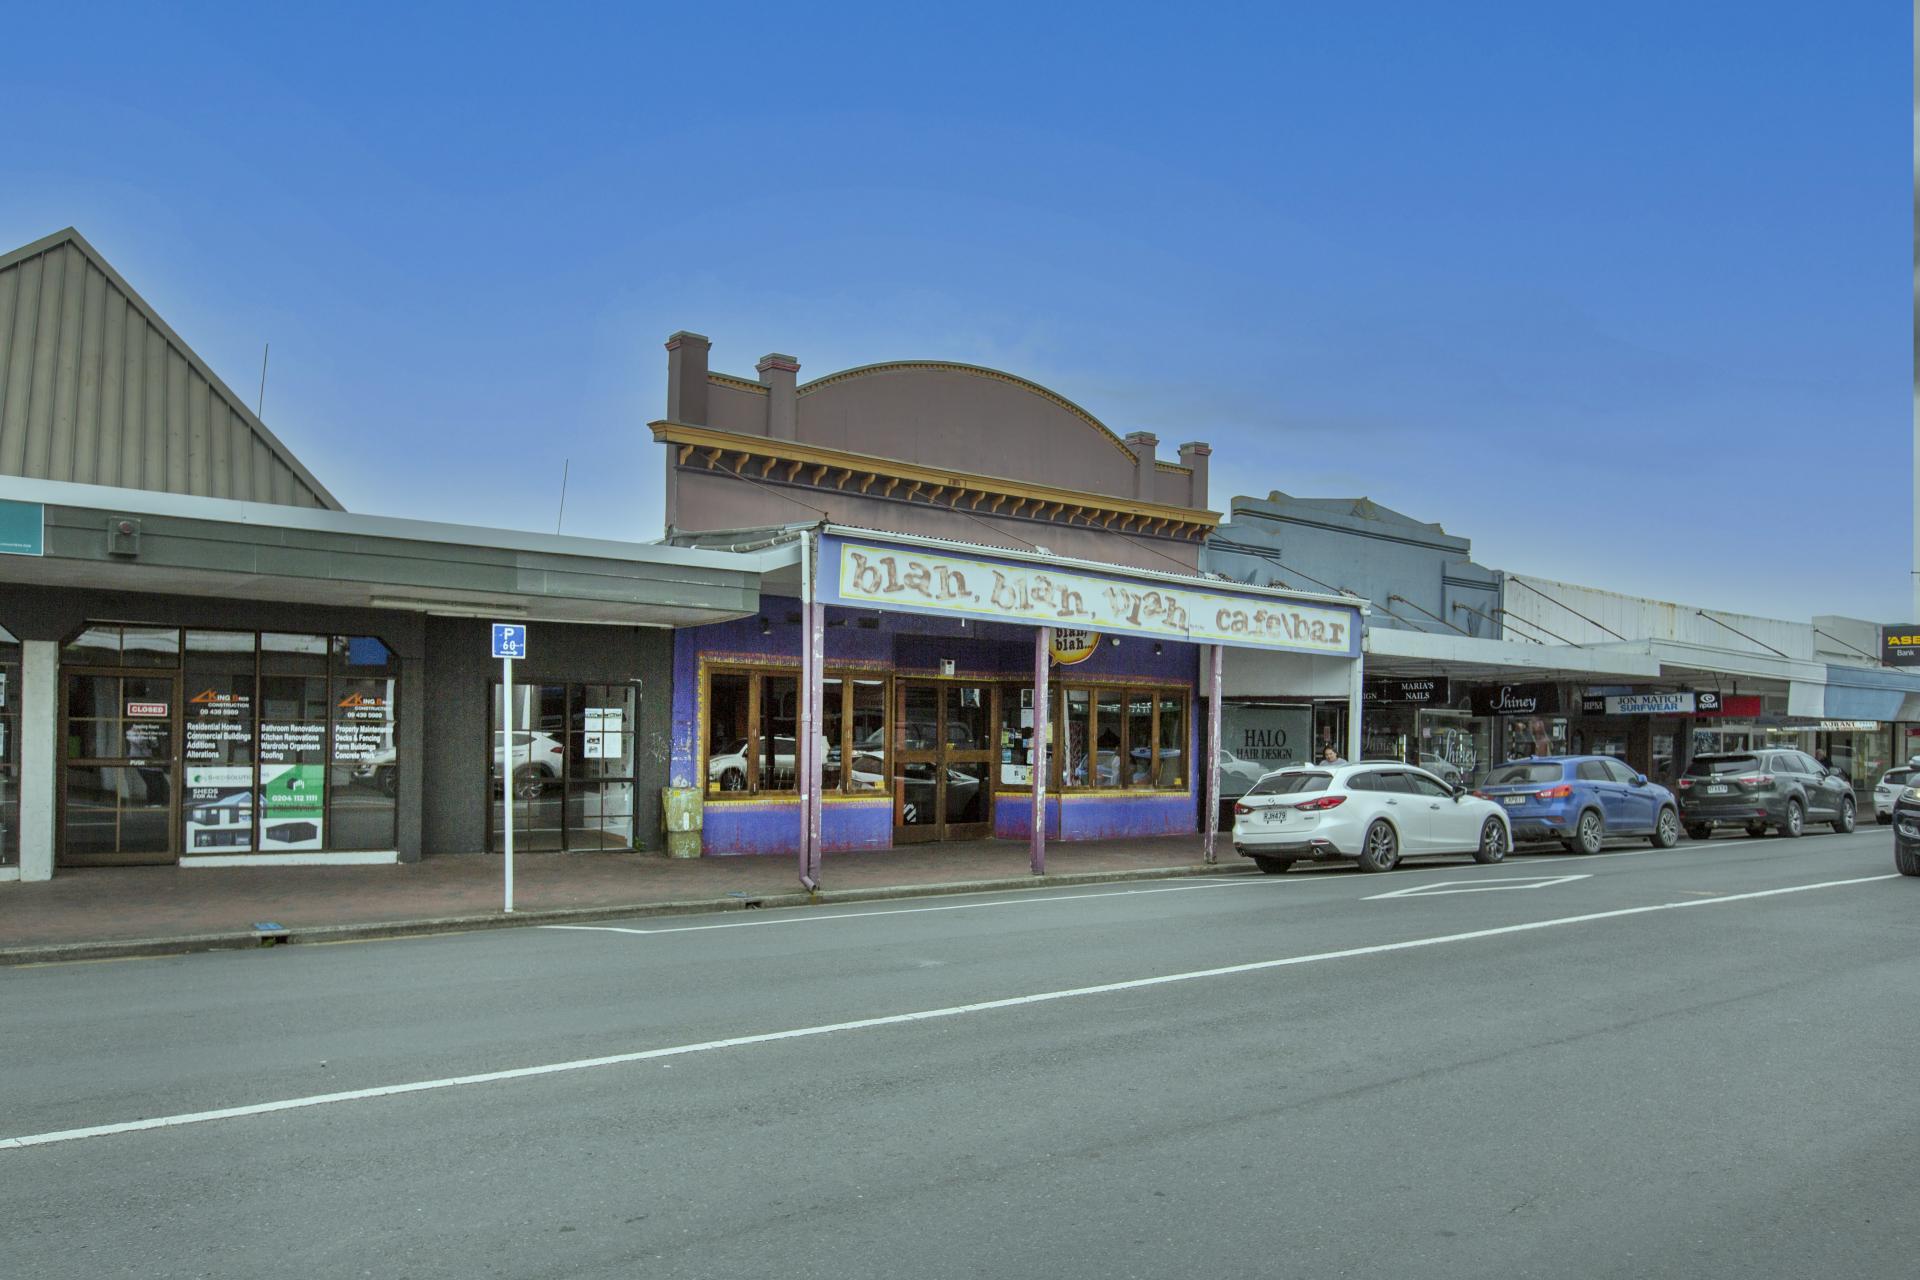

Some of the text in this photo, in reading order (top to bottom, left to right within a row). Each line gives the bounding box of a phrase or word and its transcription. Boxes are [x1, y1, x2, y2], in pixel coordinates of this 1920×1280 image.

[504, 628, 514, 640] P
[503, 640, 516, 650] 60
[1401, 682, 1434, 690] MARIA'S
[1405, 692, 1430, 700] NAILS
[1618, 696, 1639, 705] JON
[1620, 703, 1677, 712] SURFWEAR
[187, 722, 242, 730] Residential Homes
[261, 724, 326, 732] Bathroom Renovations
[336, 725, 359, 734] Property
[187, 732, 251, 742] Commercial Buildings
[261, 733, 319, 741] Kitchen Renovations
[359, 734, 380, 743] Fencing
[1245, 728, 1286, 747] HALO
[187, 741, 216, 749] Additions
[261, 742, 320, 752] Wardrobe Organisers
[351, 743, 376, 752] Buildings
[187, 750, 220, 758] Alterations
[261, 751, 283, 760] Roofing
[335, 751, 360, 759] Concrete
[1236, 748, 1293, 760] HAIR DESIGN
